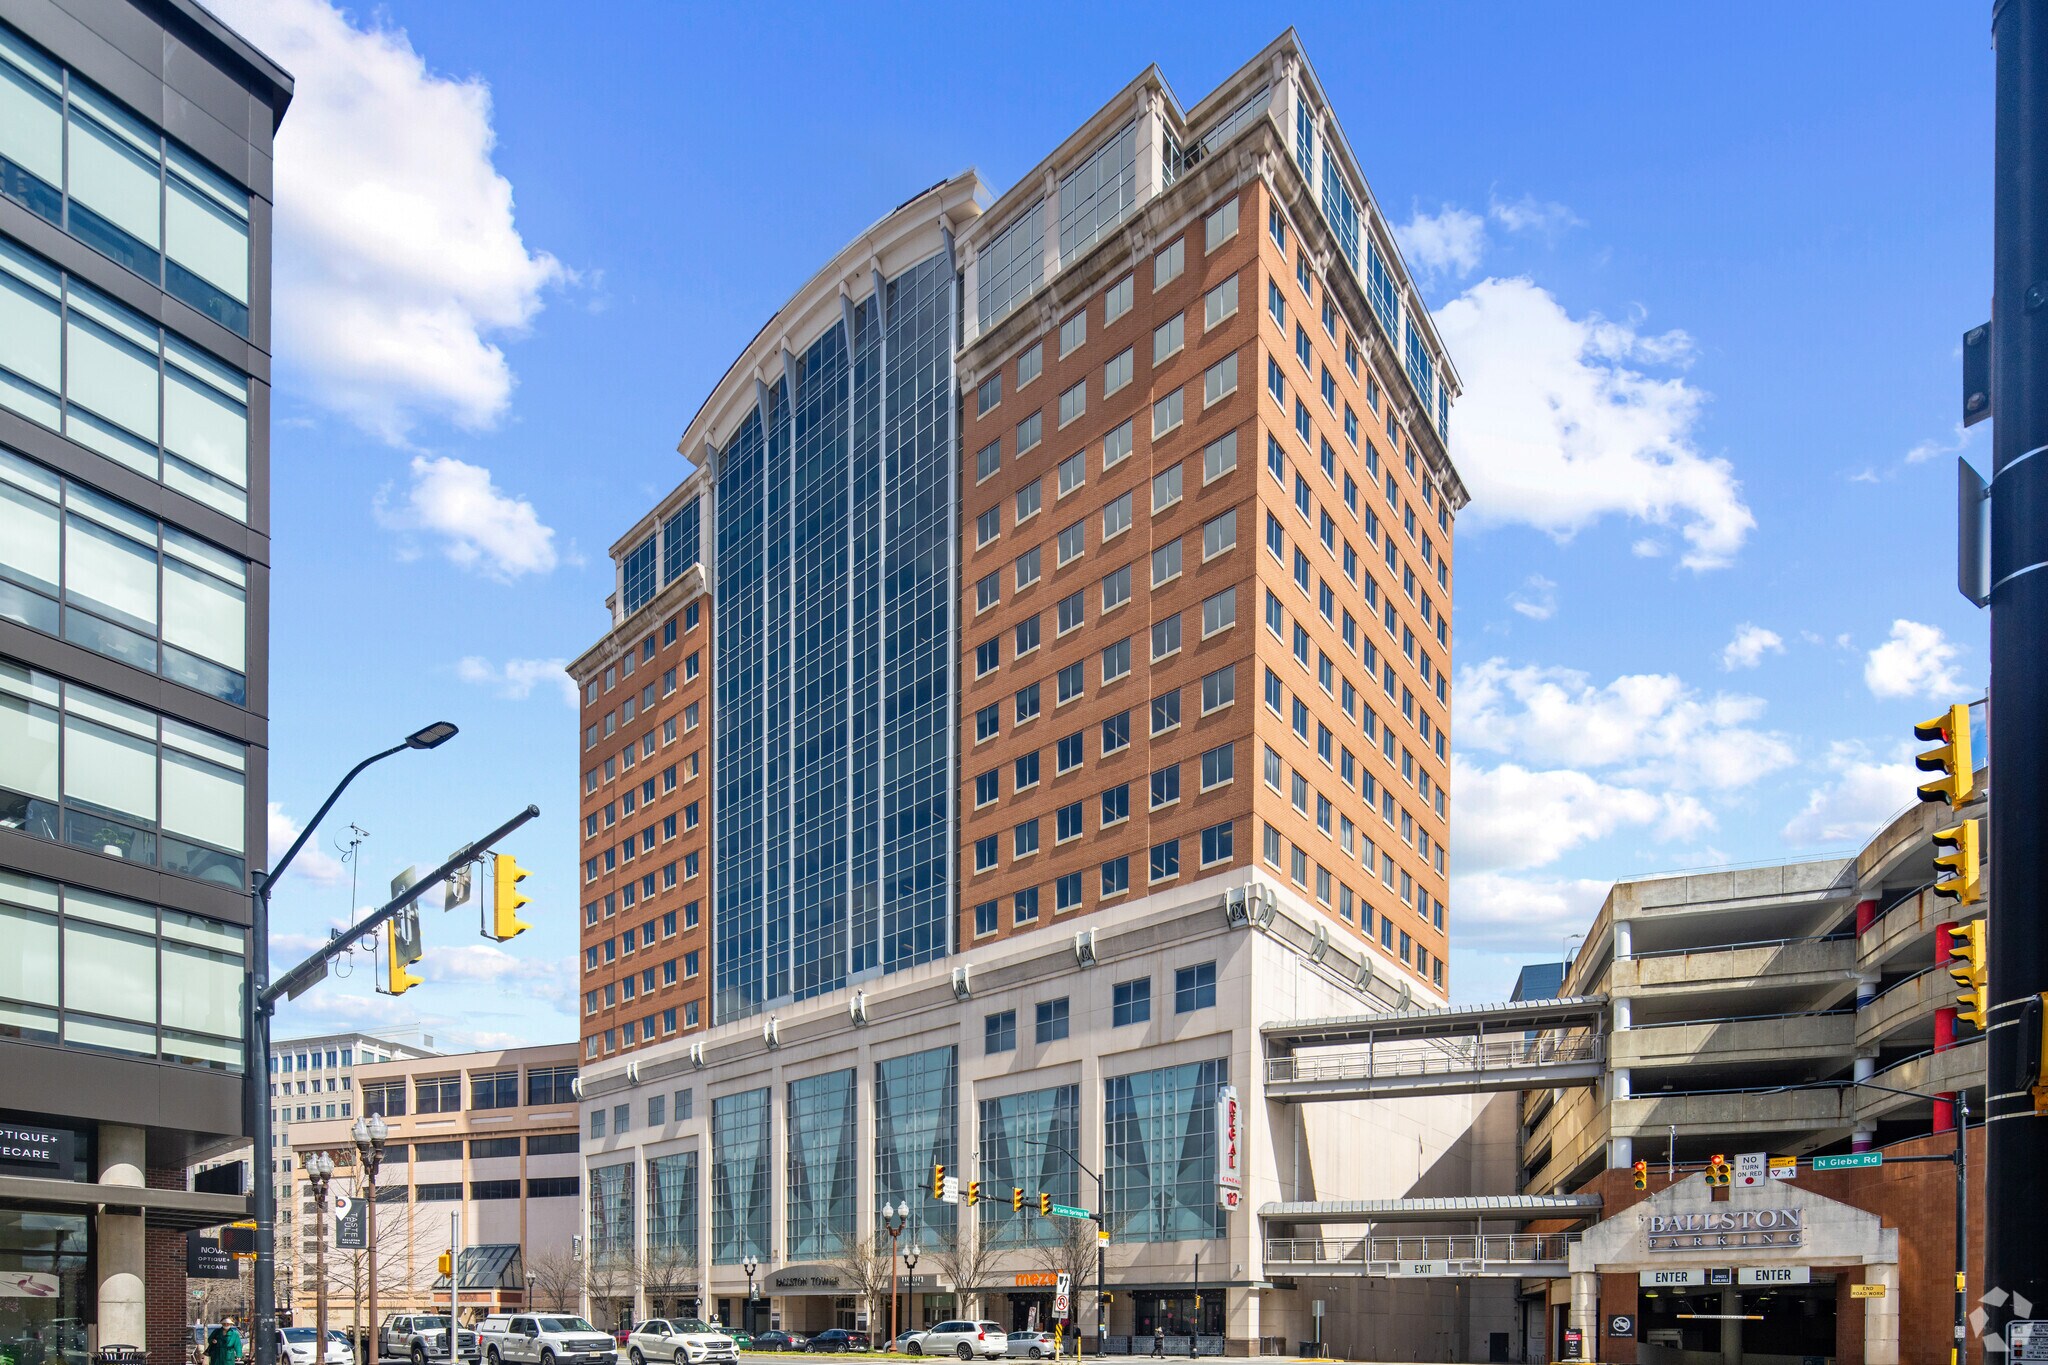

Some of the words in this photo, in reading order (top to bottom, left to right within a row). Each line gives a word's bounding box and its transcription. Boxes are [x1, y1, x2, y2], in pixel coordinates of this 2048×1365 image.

[1228, 1101, 1237, 1169] REGAL
[0, 1147, 50, 1159] ECARE
[1830, 1158, 1859, 1166] Glebe
[1863, 1156, 1877, 1164] Rd
[1650, 1209, 1800, 1232] BALLSTON
[1649, 1233, 1800, 1248] PARKING
[1414, 1264, 1432, 1274] EXIT
[1755, 1269, 1791, 1281] ENTER
[776, 1277, 807, 1287] BALLSTON
[810, 1276, 840, 1286] TOWER
[1015, 1269, 1063, 1286] meze
[1655, 1271, 1688, 1283] ENTER
